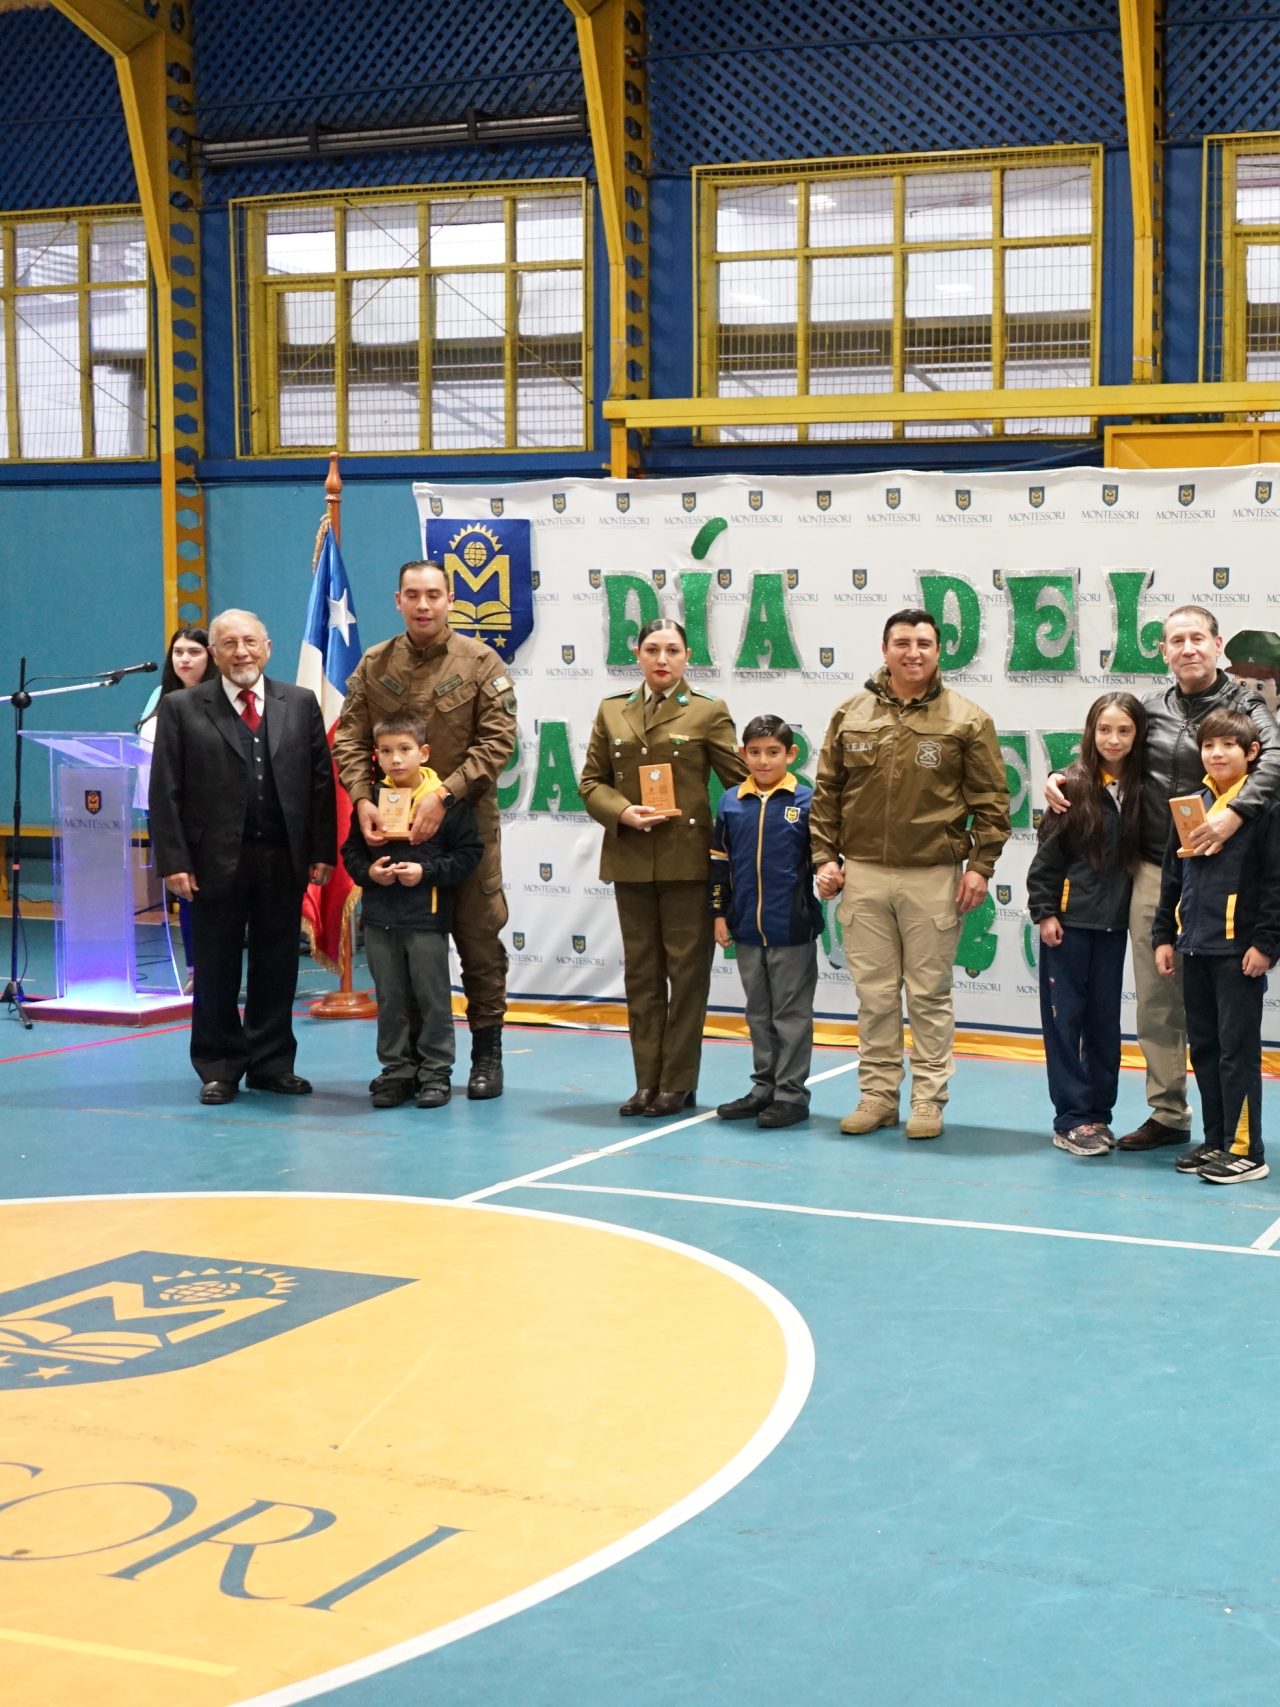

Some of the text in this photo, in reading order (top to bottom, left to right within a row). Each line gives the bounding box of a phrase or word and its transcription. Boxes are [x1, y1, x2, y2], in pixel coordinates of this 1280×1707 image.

[866, 514, 920, 522] MONTESSORI
[936, 514, 992, 523] MONTESSORI
[1008, 512, 1065, 522] MONTESSORI
[1082, 510, 1139, 520] MONTESSORI
[1156, 510, 1216, 520] MONTESSORI
[731, 515, 782, 524] MONTESSORI
[798, 515, 852, 524] MONTESSORI
[790, 594, 818, 602] ESSORI
[834, 594, 887, 602] MONTESSORI
[1144, 594, 1174, 602] ESSORI
[1192, 594, 1250, 602] MONTESSORI
[918, 571, 1170, 673] DEL
[801, 672, 854, 680] MONTESSORI
[1008, 676, 1064, 684] MONTESSORI
[1080, 676, 1136, 684] MONTESSORI
[954, 982, 1001, 992] ONTESSORI
